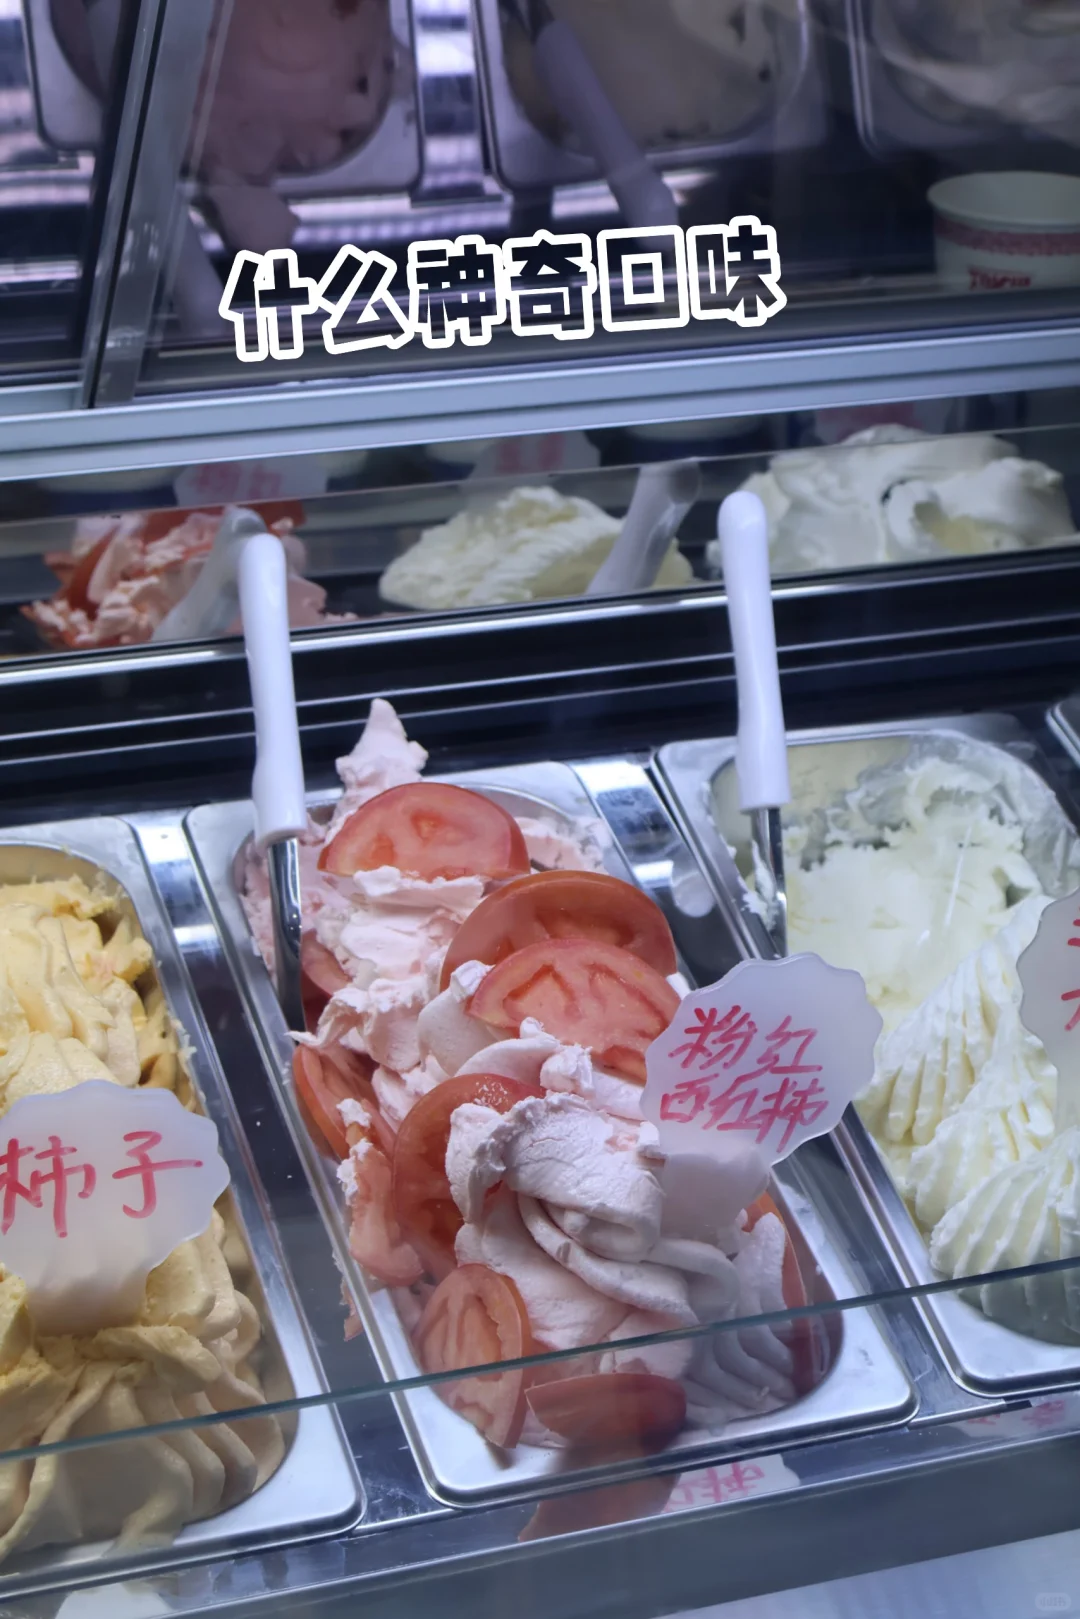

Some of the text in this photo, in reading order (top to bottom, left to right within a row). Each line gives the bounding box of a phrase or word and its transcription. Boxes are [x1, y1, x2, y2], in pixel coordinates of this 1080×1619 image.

[668, 1004, 823, 1074] 粉红
[659, 1072, 829, 1153] 西红柿
[0, 1130, 204, 1238] 柿子
